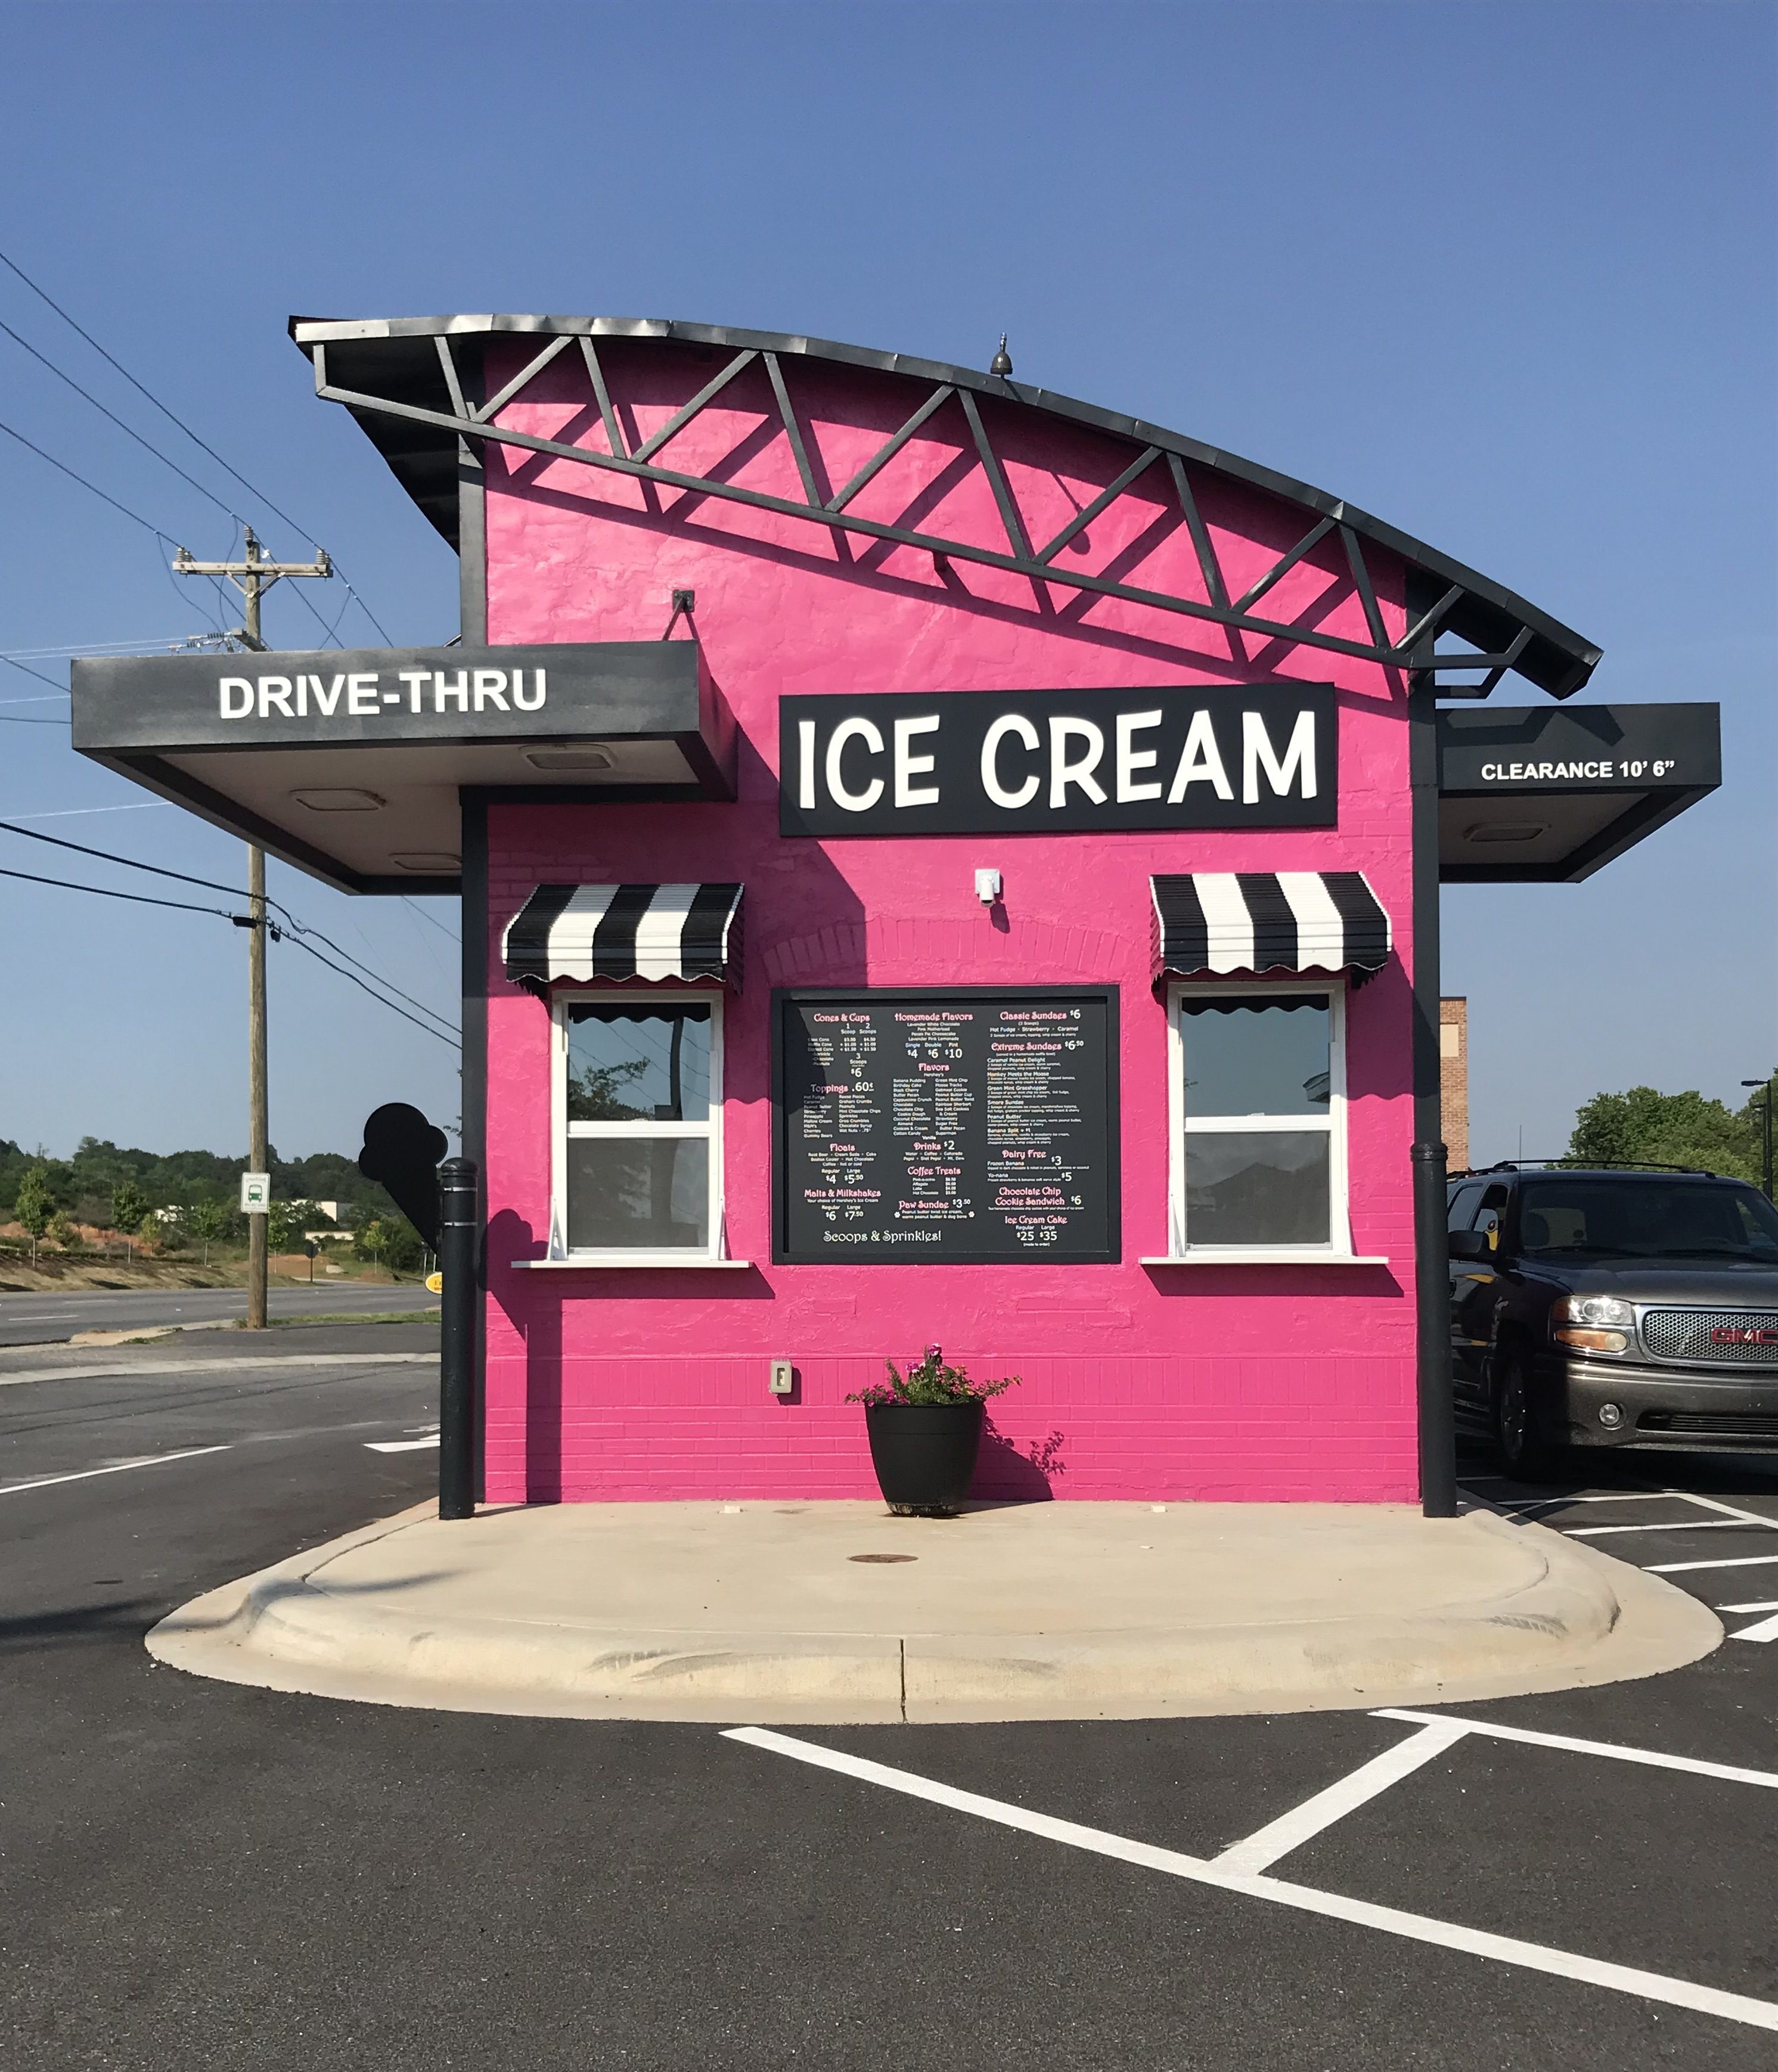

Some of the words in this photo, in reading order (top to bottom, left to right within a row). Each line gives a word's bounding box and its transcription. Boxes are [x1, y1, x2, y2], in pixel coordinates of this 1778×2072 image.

[220, 669, 547, 719] DRIVE-THRU
[799, 714, 941, 812] ICE
[980, 709, 1317, 809] CREAM
[1481, 762, 1613, 780] CLEARANCE
[814, 1013, 839, 1022] Cones
[841, 1013, 848, 1021] &
[849, 1012, 870, 1023] Cups
[894, 1013, 941, 1021] Homemade
[942, 1012, 973, 1021] Flavors
[1000, 1011, 1030, 1020] Classic
[1031, 1011, 1067, 1020] Sundaes
[1069, 1009, 1081, 1019] $6
[991, 1043, 1025, 1051] Extreme
[1026, 1042, 1062, 1051] Sundaes
[908, 1049, 918, 1058] $4
[928, 1049, 939, 1058] $6
[945, 1049, 963, 1058] $10
[851, 1067, 862, 1077] $6
[919, 1063, 950, 1071] Flavors
[811, 1084, 849, 1094] Toppings
[830, 1144, 855, 1152] Floats
[913, 1142, 942, 1151] Drinks
[944, 1141, 955, 1150] $2
[1002, 1150, 1025, 1160] Dairy
[1028, 1149, 1047, 1158] Free
[1051, 1156, 1062, 1166] $3
[907, 1166, 934, 1176] Coffee
[935, 1166, 961, 1175] Treats
[826, 1175, 836, 1184] $4
[1061, 1172, 1072, 1182] $5
[804, 1189, 826, 1198] Malts
[828, 1189, 835, 1198] &
[836, 1189, 882, 1198] Milkshakes
[999, 1186, 1041, 1196] Chocolate
[1042, 1186, 1062, 1196] Chip
[898, 1200, 917, 1210] Paw
[918, 1200, 949, 1209] Sundae
[995, 1197, 1025, 1206] Cookie
[1025, 1197, 1065, 1206] Sandwich
[1070, 1195, 1082, 1205] $6
[826, 1211, 836, 1220] $6
[1004, 1216, 1017, 1224] Ice
[1018, 1215, 1045, 1224] Cream
[1047, 1215, 1068, 1225] Cake
[823, 1229, 868, 1244] Scoops
[870, 1230, 880, 1241] &
[883, 1229, 942, 1243] Sprinkles!
[1016, 1231, 1034, 1241] $25
[1040, 1231, 1057, 1241] $35
[1711, 1328, 1778, 1344] GMC
